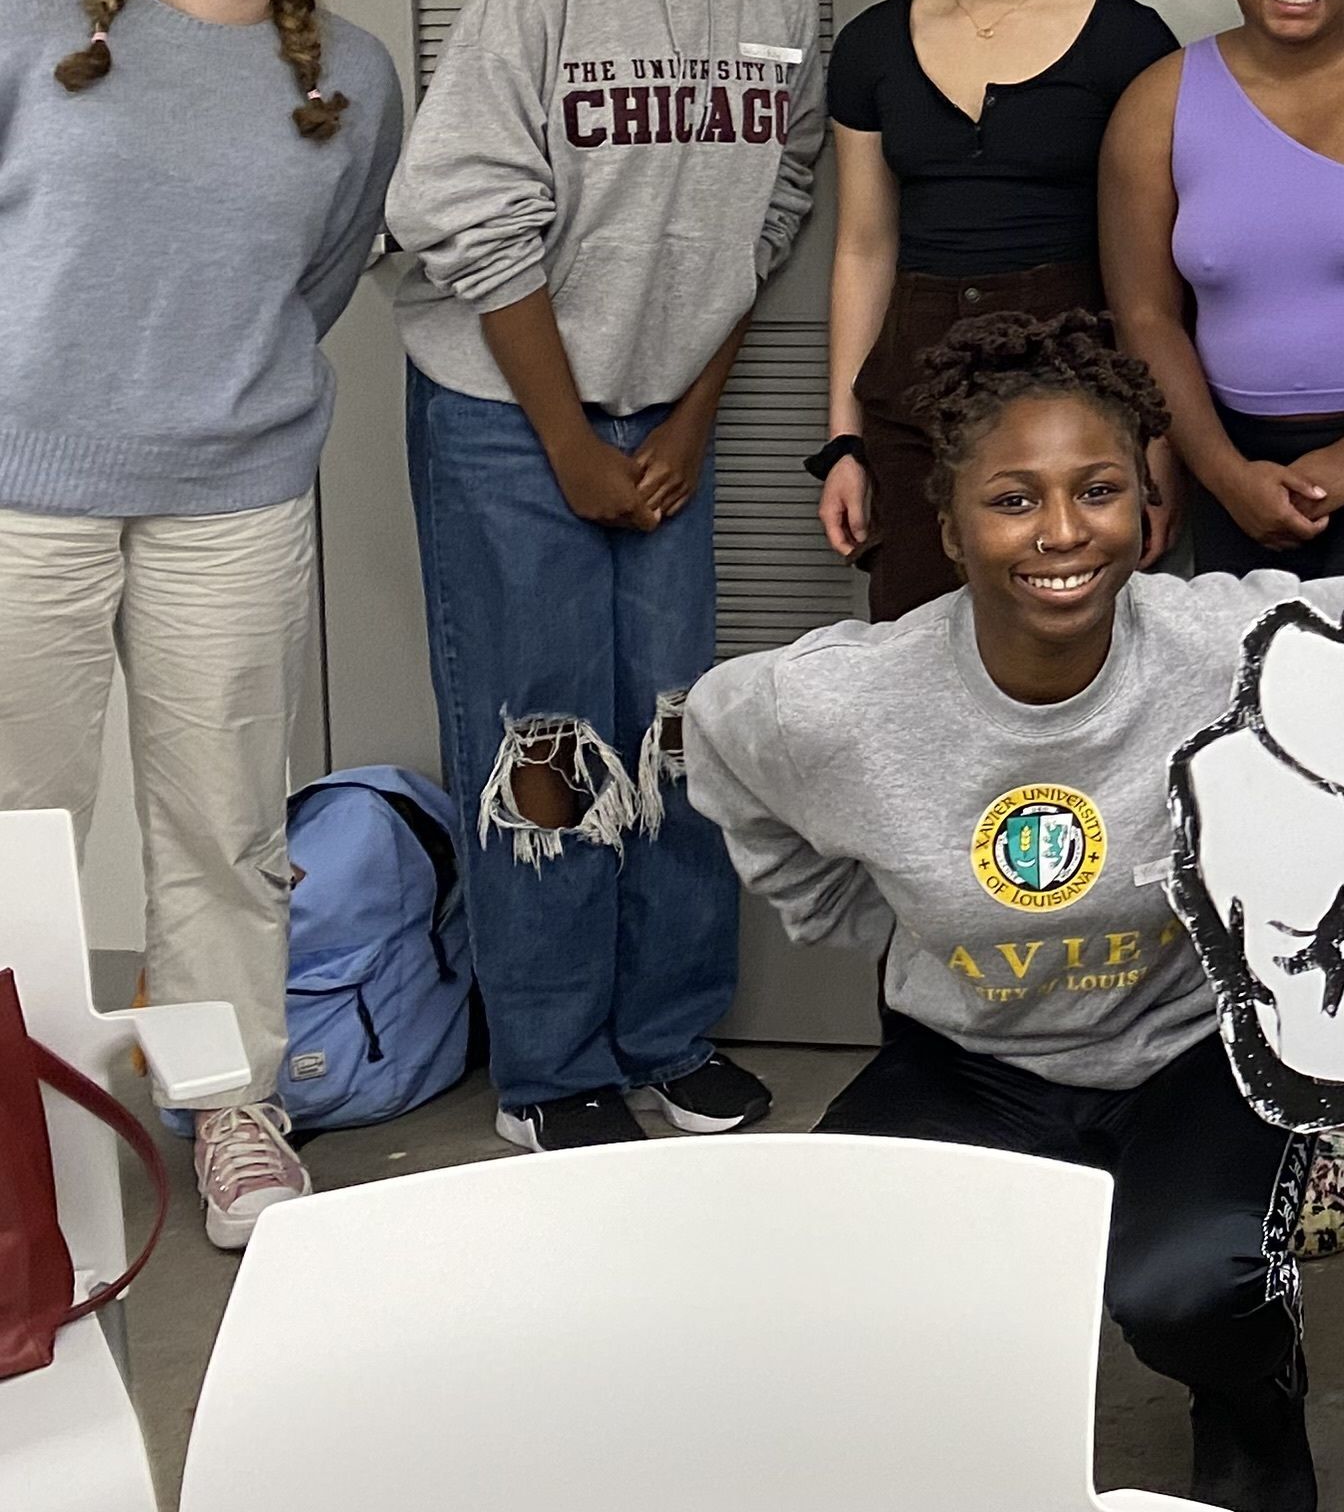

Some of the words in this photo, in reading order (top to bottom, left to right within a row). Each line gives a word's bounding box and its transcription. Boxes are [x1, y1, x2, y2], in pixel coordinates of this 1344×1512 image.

[563, 60, 616, 84] THE
[562, 85, 791, 149] CHICAGO
[975, 796, 1017, 850] XAVIER
[1022, 787, 1103, 843] UNIVERSITY
[986, 875, 1009, 895] OF
[1010, 870, 1096, 907] LOUISIANA
